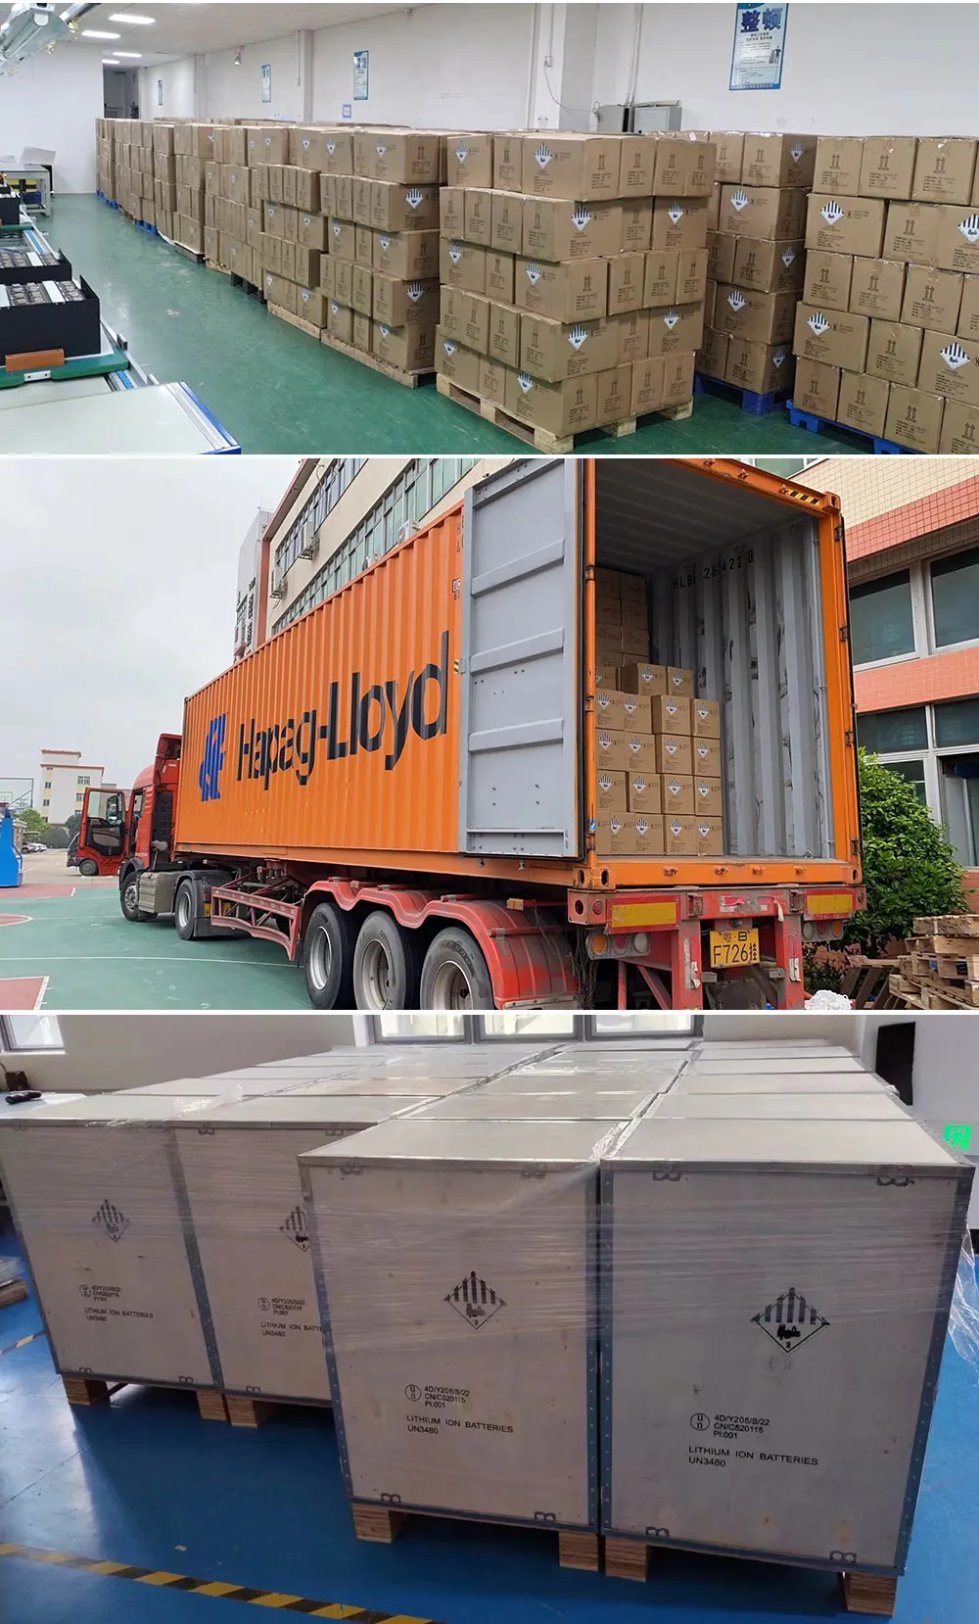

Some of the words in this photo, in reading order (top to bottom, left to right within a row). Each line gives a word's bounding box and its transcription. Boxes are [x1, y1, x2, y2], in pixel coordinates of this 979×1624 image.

[740, 8, 782, 33] 整顿
[237, 630, 449, 790] Hapag-Lloyd
[713, 943, 758, 965] F726挂
[406, 1414, 441, 1425] LITHIUM
[445, 1419, 461, 1427] ION
[465, 1421, 514, 1434] BATTERIES
[407, 1425, 439, 1435] UN3480
[688, 1445, 730, 1457] LITHIUM
[735, 1450, 755, 1459] ION
[759, 1453, 819, 1466] BATTERIES
[688, 1457, 726, 1467] UN3480
